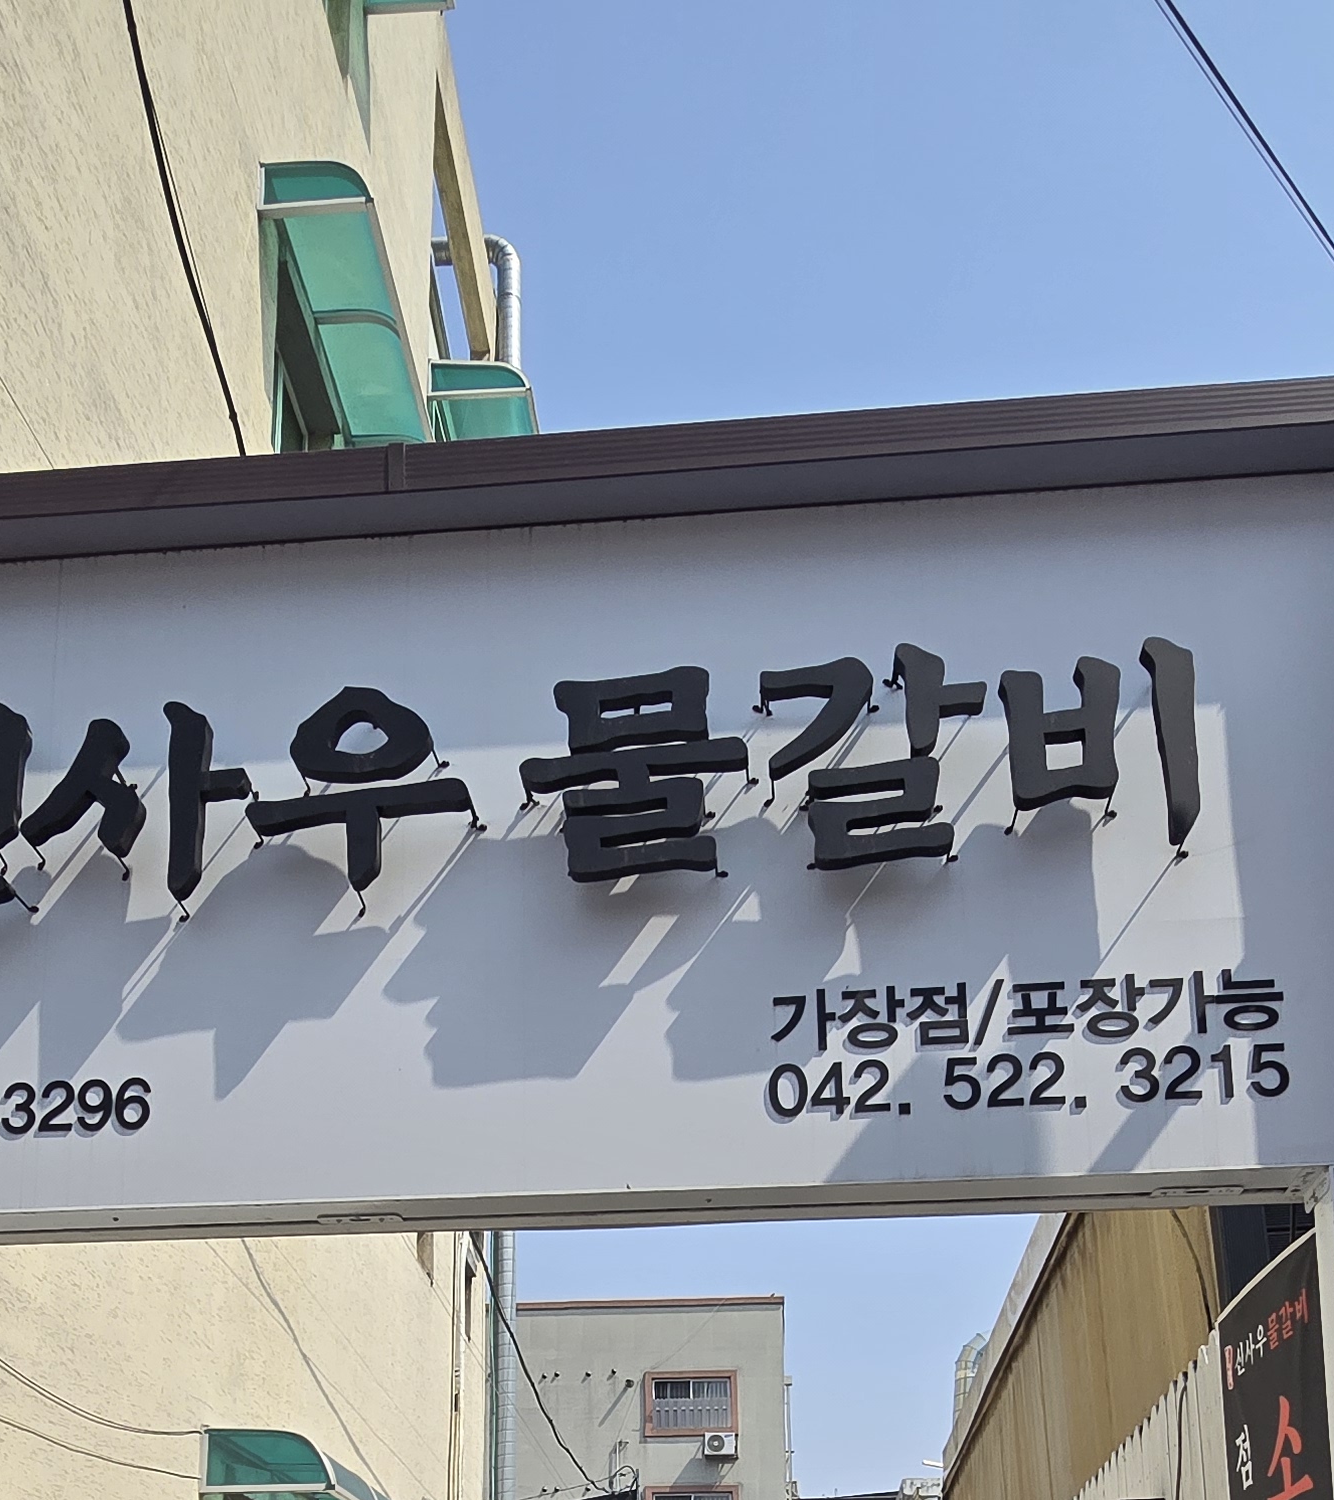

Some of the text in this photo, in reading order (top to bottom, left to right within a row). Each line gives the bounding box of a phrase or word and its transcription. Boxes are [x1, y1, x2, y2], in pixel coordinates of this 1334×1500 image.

[519, 636, 1201, 884] 물갈비
[770, 970, 1285, 1051] 가장점/포장가능
[768, 1043, 1289, 1118] 042. 522. 3215
